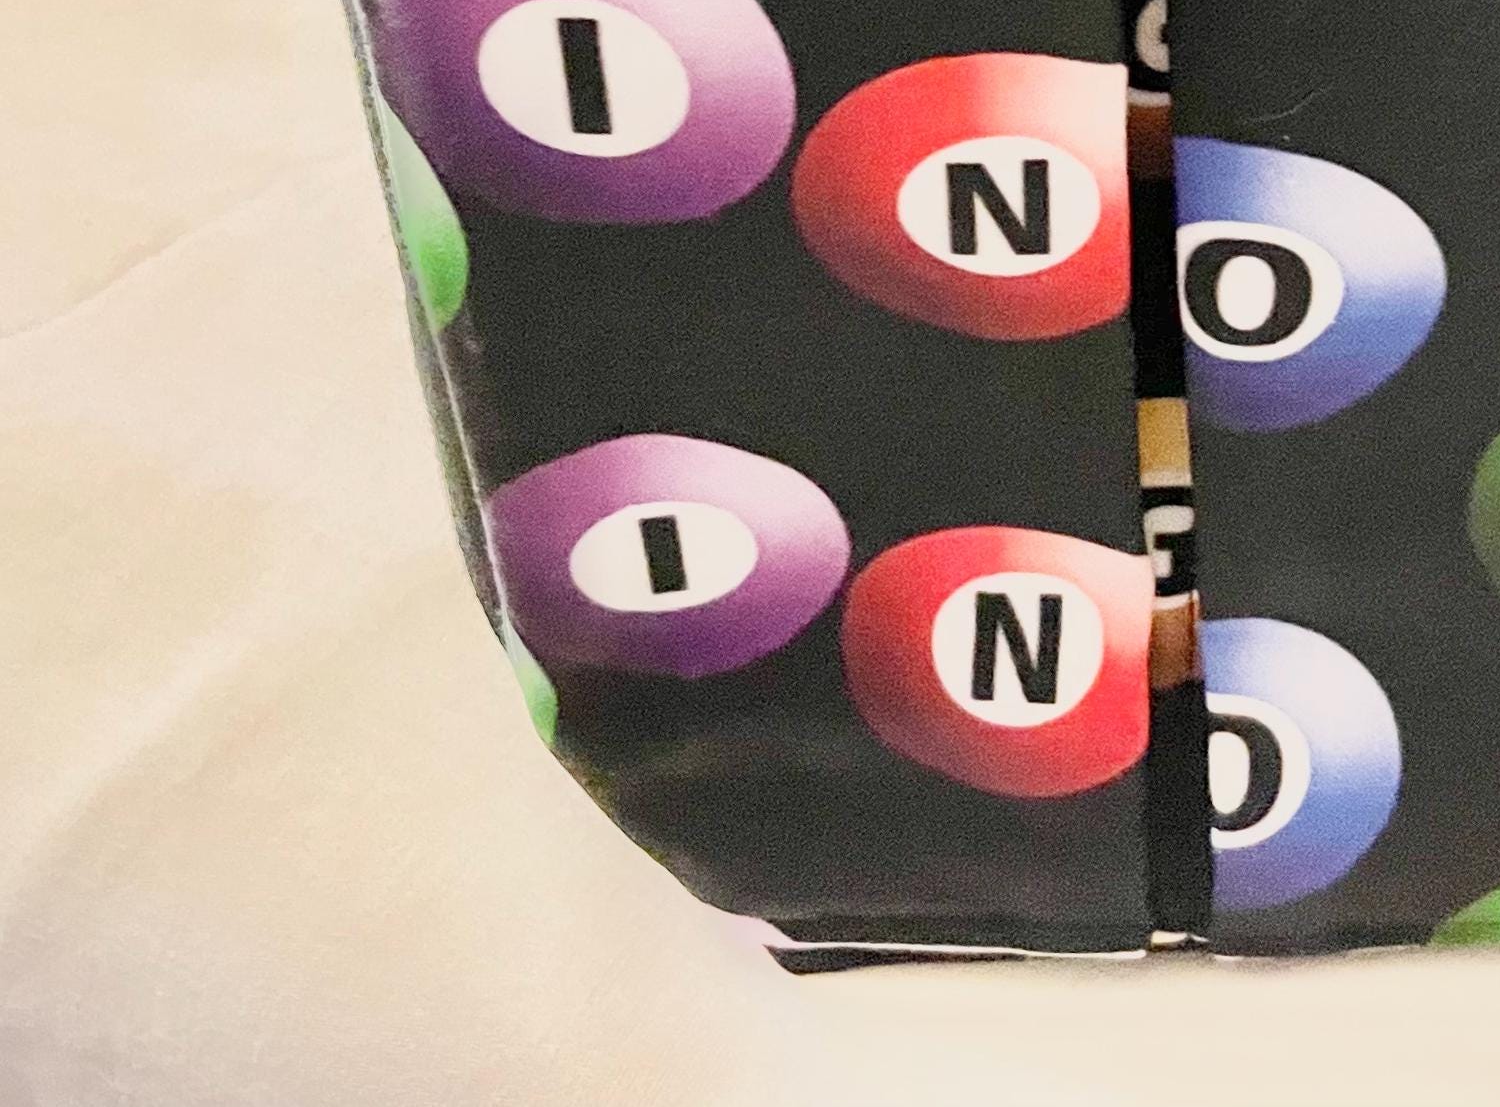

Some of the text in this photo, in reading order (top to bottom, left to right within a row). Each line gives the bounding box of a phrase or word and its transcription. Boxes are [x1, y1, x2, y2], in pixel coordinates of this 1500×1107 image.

[557, 18, 612, 134] I
[945, 159, 1051, 255] N
[1184, 238, 1313, 346] O
[638, 514, 688, 594] I
[971, 591, 1063, 704] N
